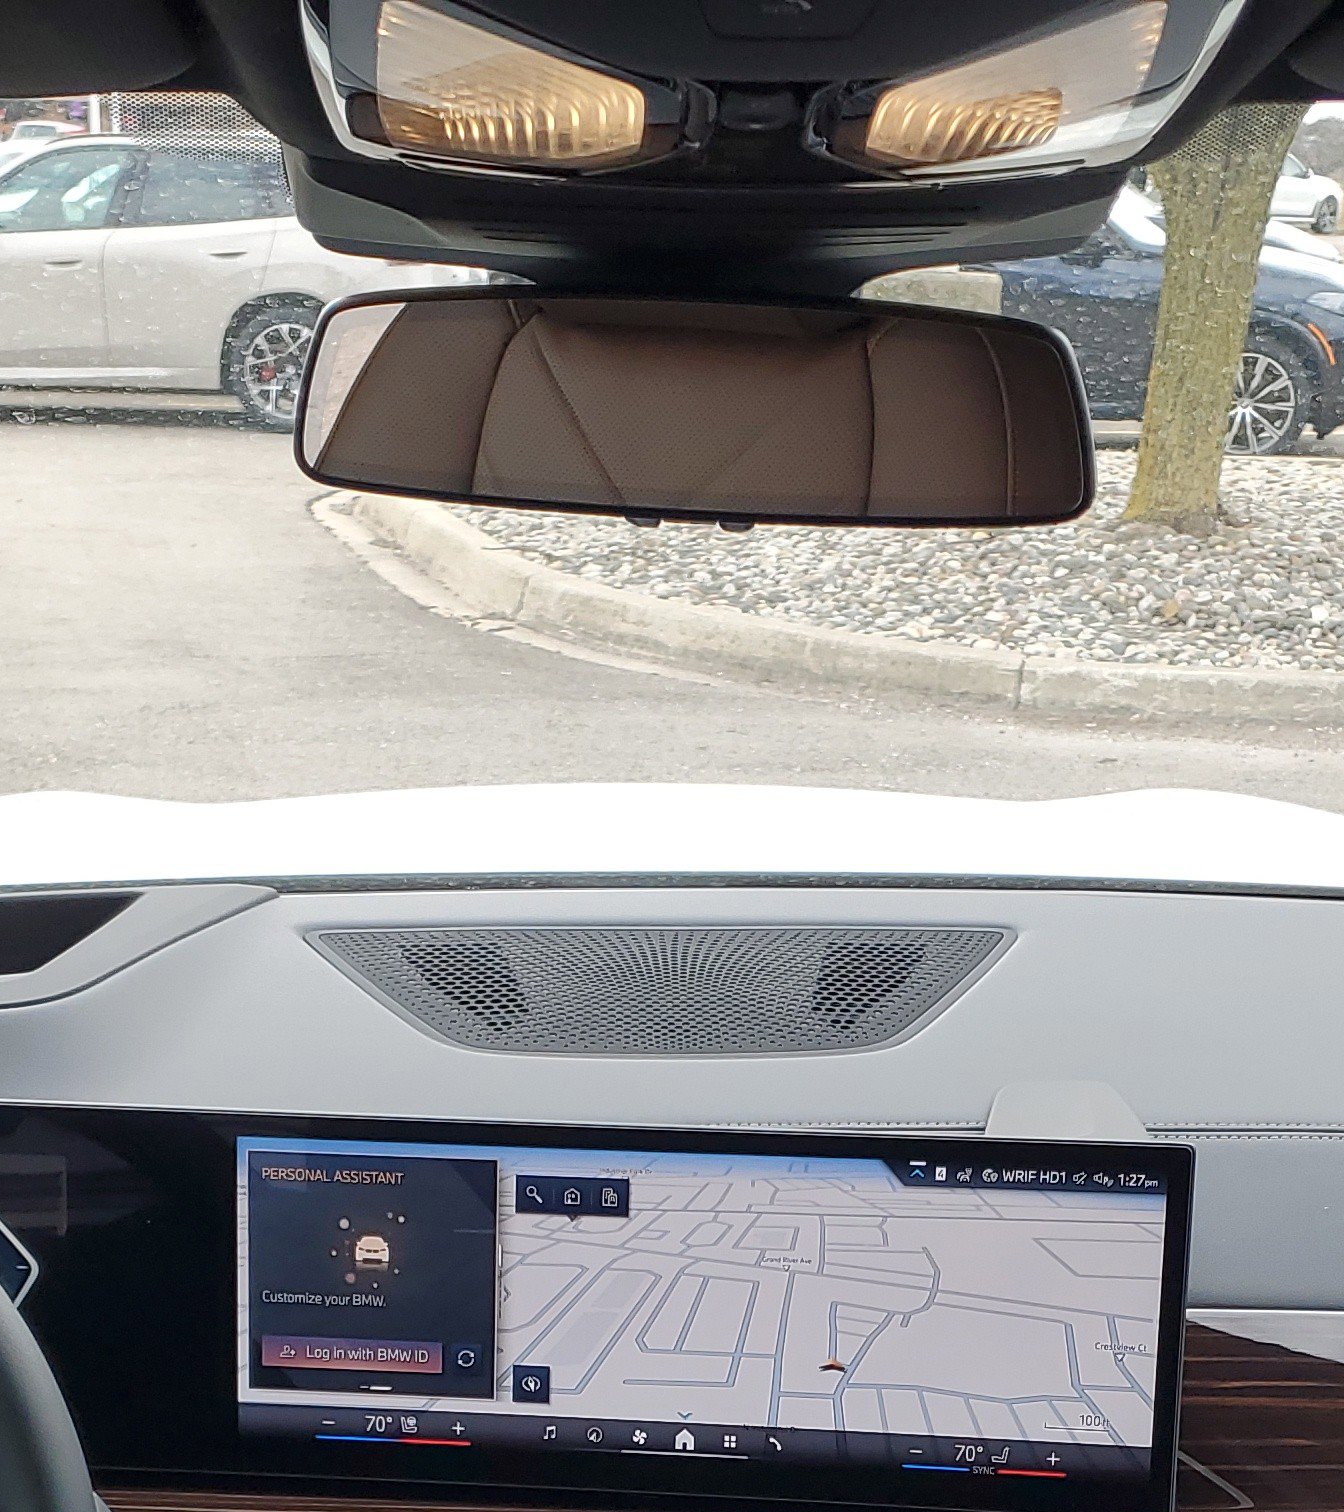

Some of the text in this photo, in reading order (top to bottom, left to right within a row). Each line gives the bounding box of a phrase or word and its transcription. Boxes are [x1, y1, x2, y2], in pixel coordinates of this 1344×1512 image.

[261, 1167, 405, 1185] PERSONAL ASSISTANT
[1002, 1169, 1067, 1184] WRIF HD1
[1117, 1174, 1159, 1188] 1:27pm
[262, 1290, 387, 1307] Customize your BMW.
[306, 1345, 330, 1360] Log
[347, 1347, 374, 1361] with
[377, 1348, 411, 1362] BMW
[414, 1350, 429, 1363] ID
[1079, 1414, 1101, 1427] 100
[972, 1466, 995, 1475] SYNC
